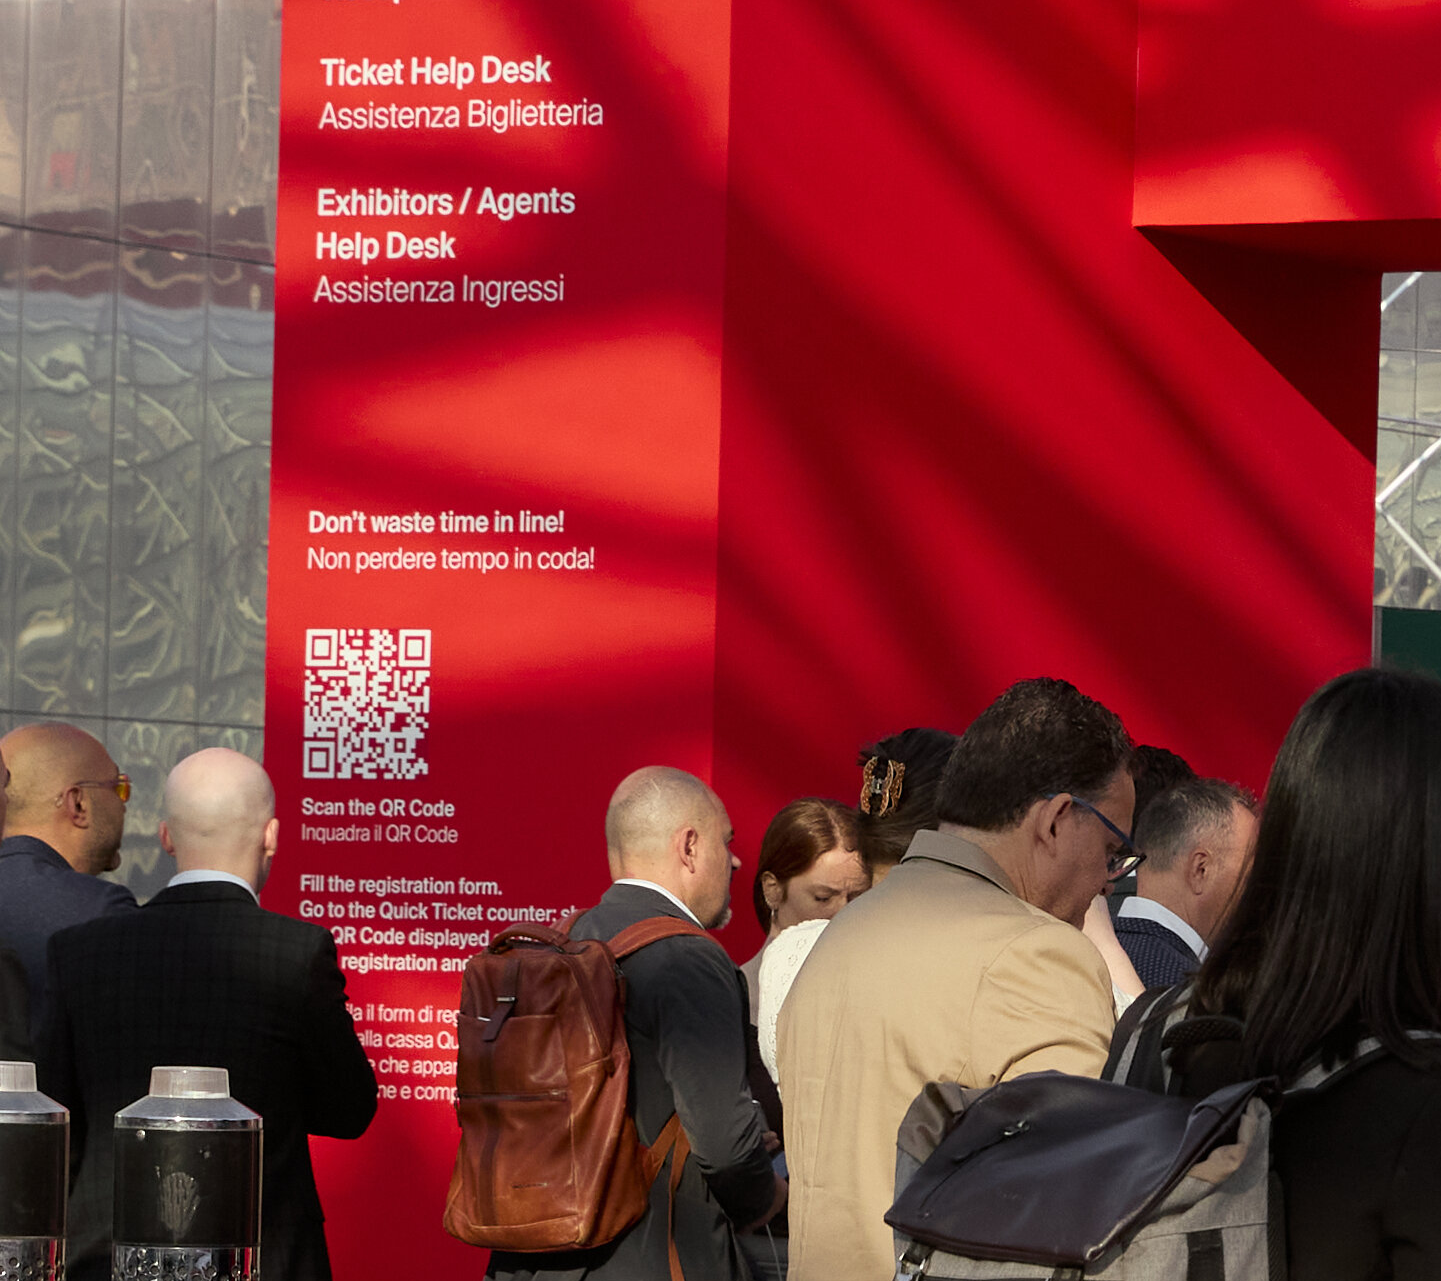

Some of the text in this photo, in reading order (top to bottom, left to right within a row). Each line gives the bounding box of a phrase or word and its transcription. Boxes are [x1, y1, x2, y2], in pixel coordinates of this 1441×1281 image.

[320, 55, 552, 91] Ticket Help Desk
[319, 98, 604, 134] Assistenza Biglietteria
[317, 187, 576, 222] Exhibitors / Agents
[315, 230, 457, 266] Help Desk
[313, 274, 565, 309] Assistenza Ingressi
[307, 509, 565, 534] Don't waste time in line!
[306, 547, 595, 575] Non perdere tempo in coda!
[301, 797, 455, 817] Scan the QR Code
[301, 824, 458, 845] Inquadra il QR Code
[300, 874, 503, 897] Fill the registration form.
[299, 899, 325, 918] Go
[327, 901, 345, 918] to
[348, 901, 376, 919] the
[379, 901, 428, 921] Quick
[431, 902, 483, 921] Ticket
[330, 925, 357, 945] QR
[359, 926, 406, 946] Code
[408, 928, 490, 950] displayed
[341, 953, 438, 974] registration
[366, 1004, 375, 1021] il
[378, 1004, 414, 1023] form
[417, 1005, 434, 1023] di
[436, 1009, 460, 1027] reg
[385, 1032, 434, 1049] cassa
[437, 1030, 459, 1050] Qu
[378, 1056, 409, 1074] che
[412, 1059, 458, 1078] appar
[400, 1085, 412, 1100] e
[414, 1085, 459, 1104] comp
